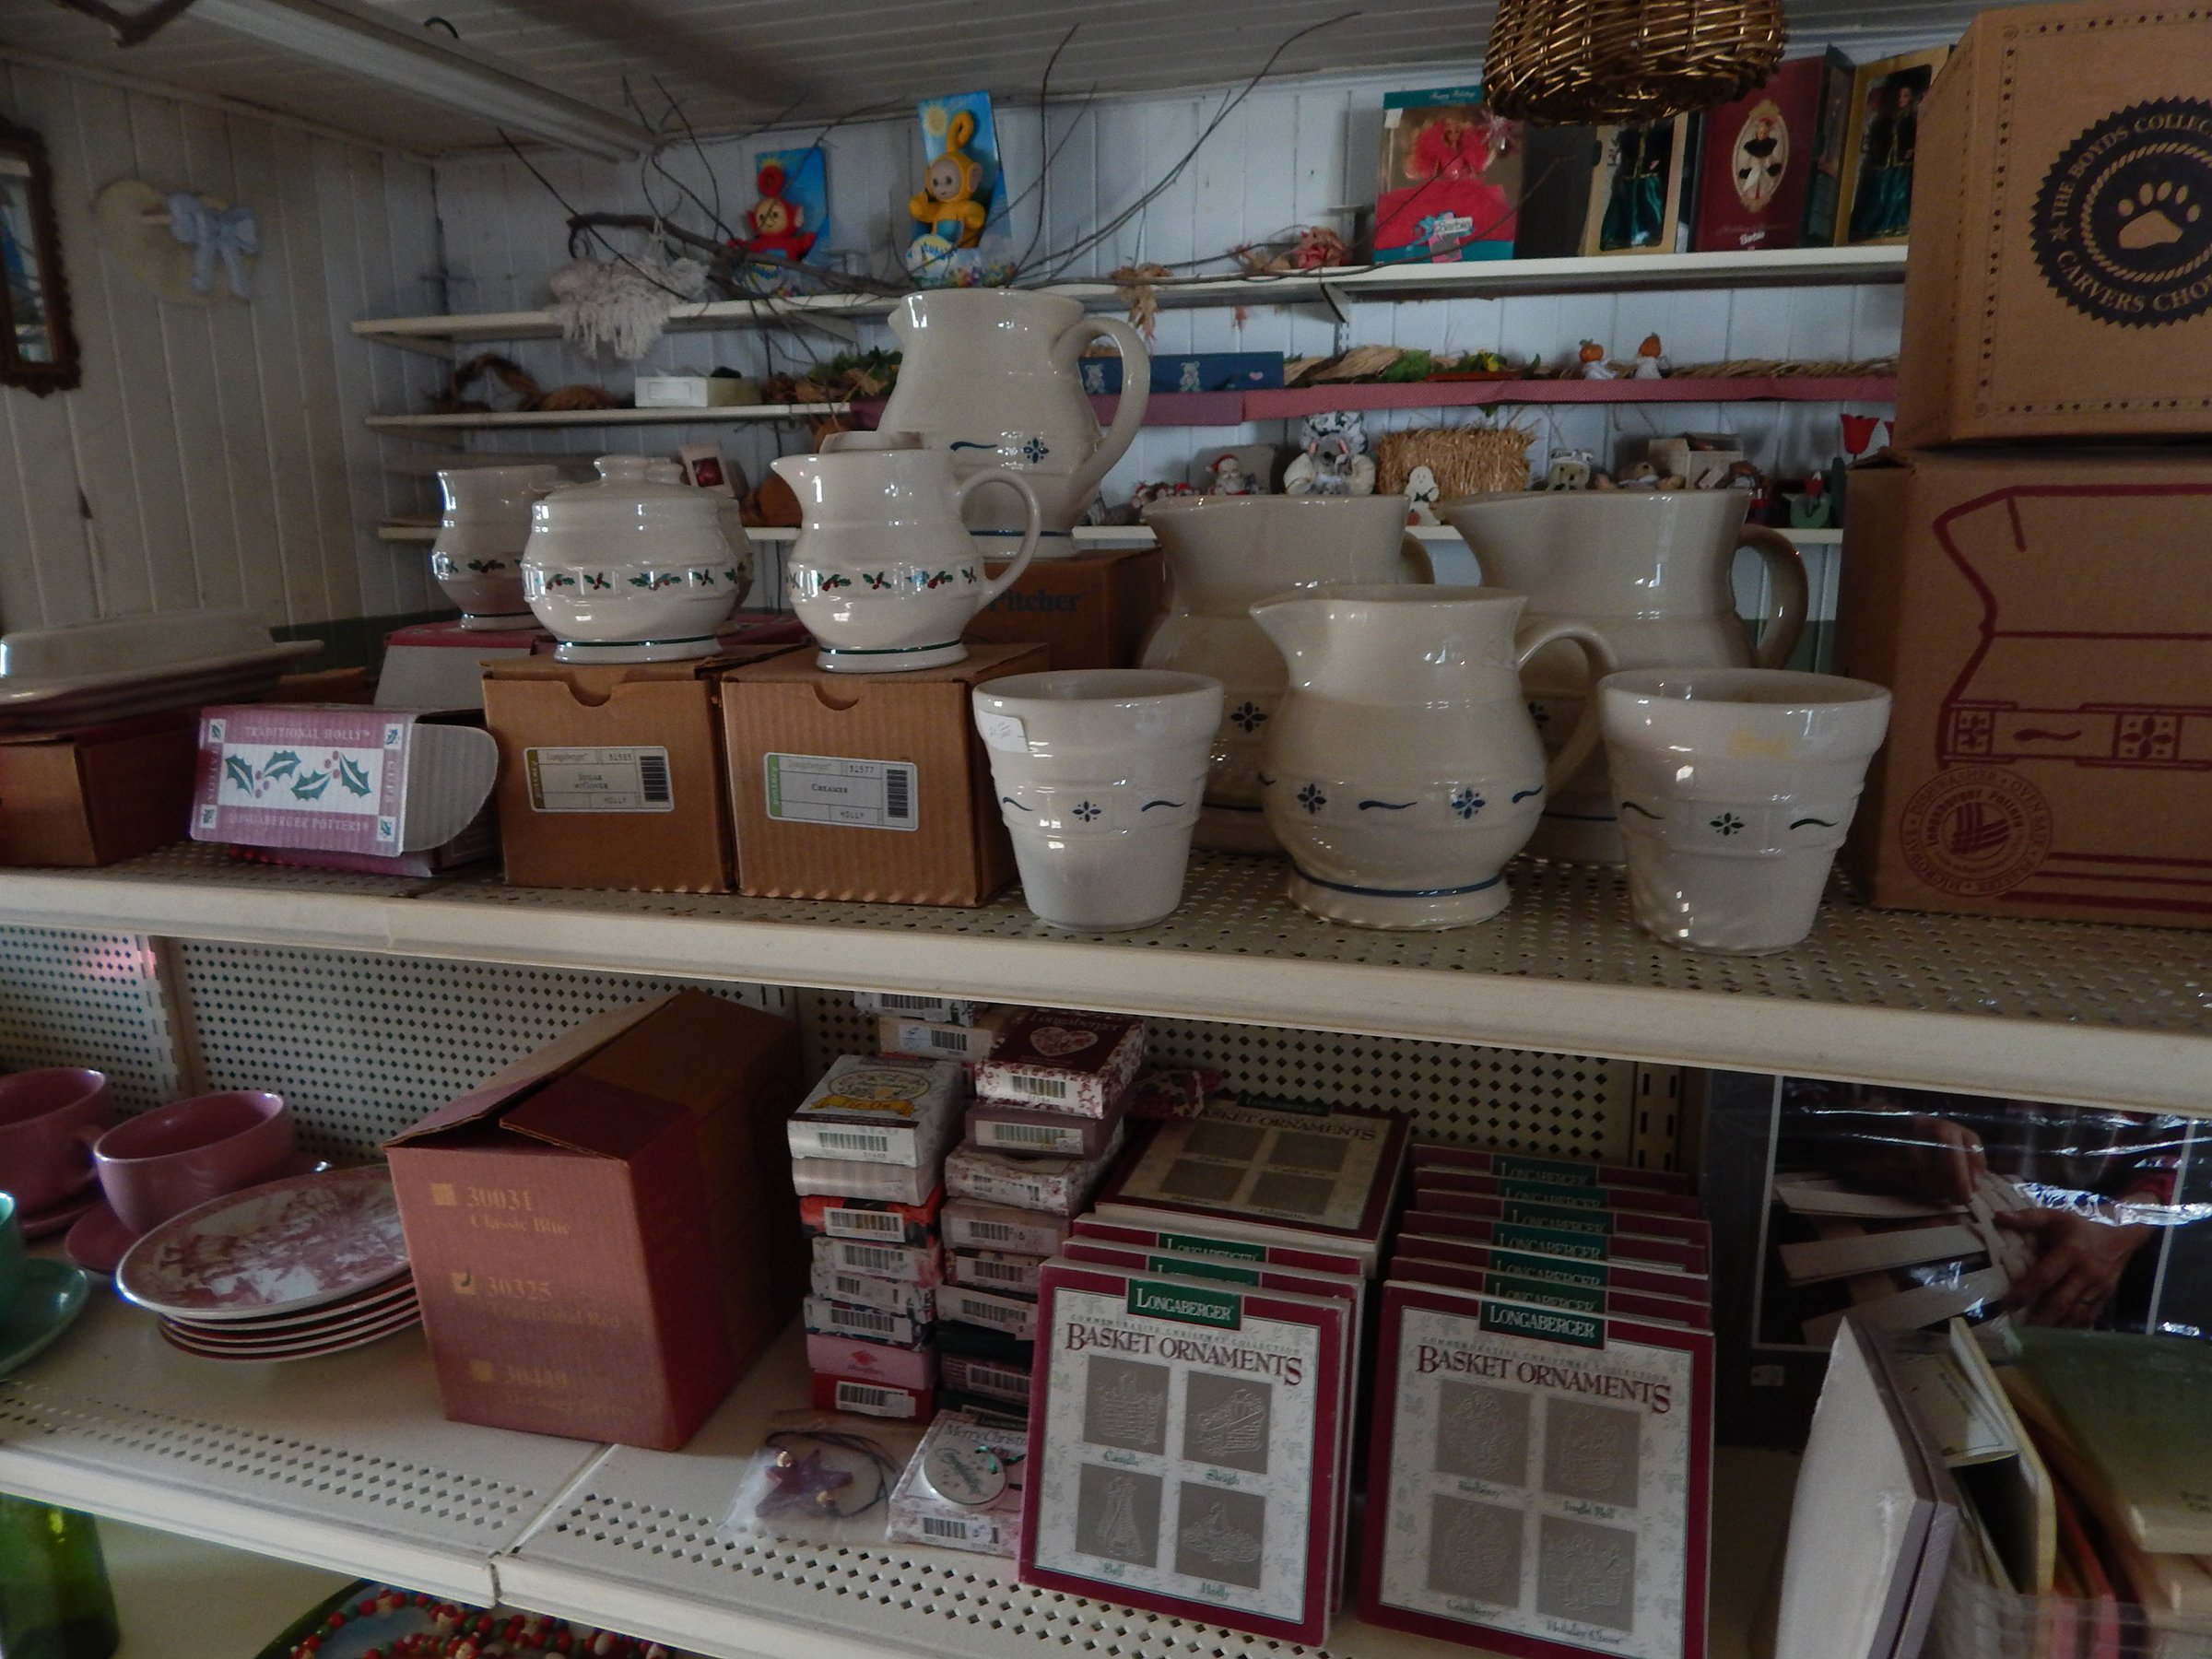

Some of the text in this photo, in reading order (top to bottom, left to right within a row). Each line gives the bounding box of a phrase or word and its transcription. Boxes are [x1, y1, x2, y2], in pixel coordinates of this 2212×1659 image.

[2050, 180, 2077, 218] THE
[2067, 125, 2129, 180] BOYDS
[2056, 249, 2146, 313] CARVERS
[242, 725, 320, 740] TRADITIONAL
[1259, 1117, 1378, 1141] ORNAMENTS
[1499, 1232, 1601, 1260] LONGABERGER
[1135, 1288, 1232, 1321] LONGABERGER
[1488, 1305, 1596, 1338] LONGABERGER
[1065, 1322, 1303, 1386] BASKET ORNAMENTS
[1231, 1339, 1300, 1354] COLLECTION
[1416, 1344, 1672, 1415] BASKET ORNAMENTS
